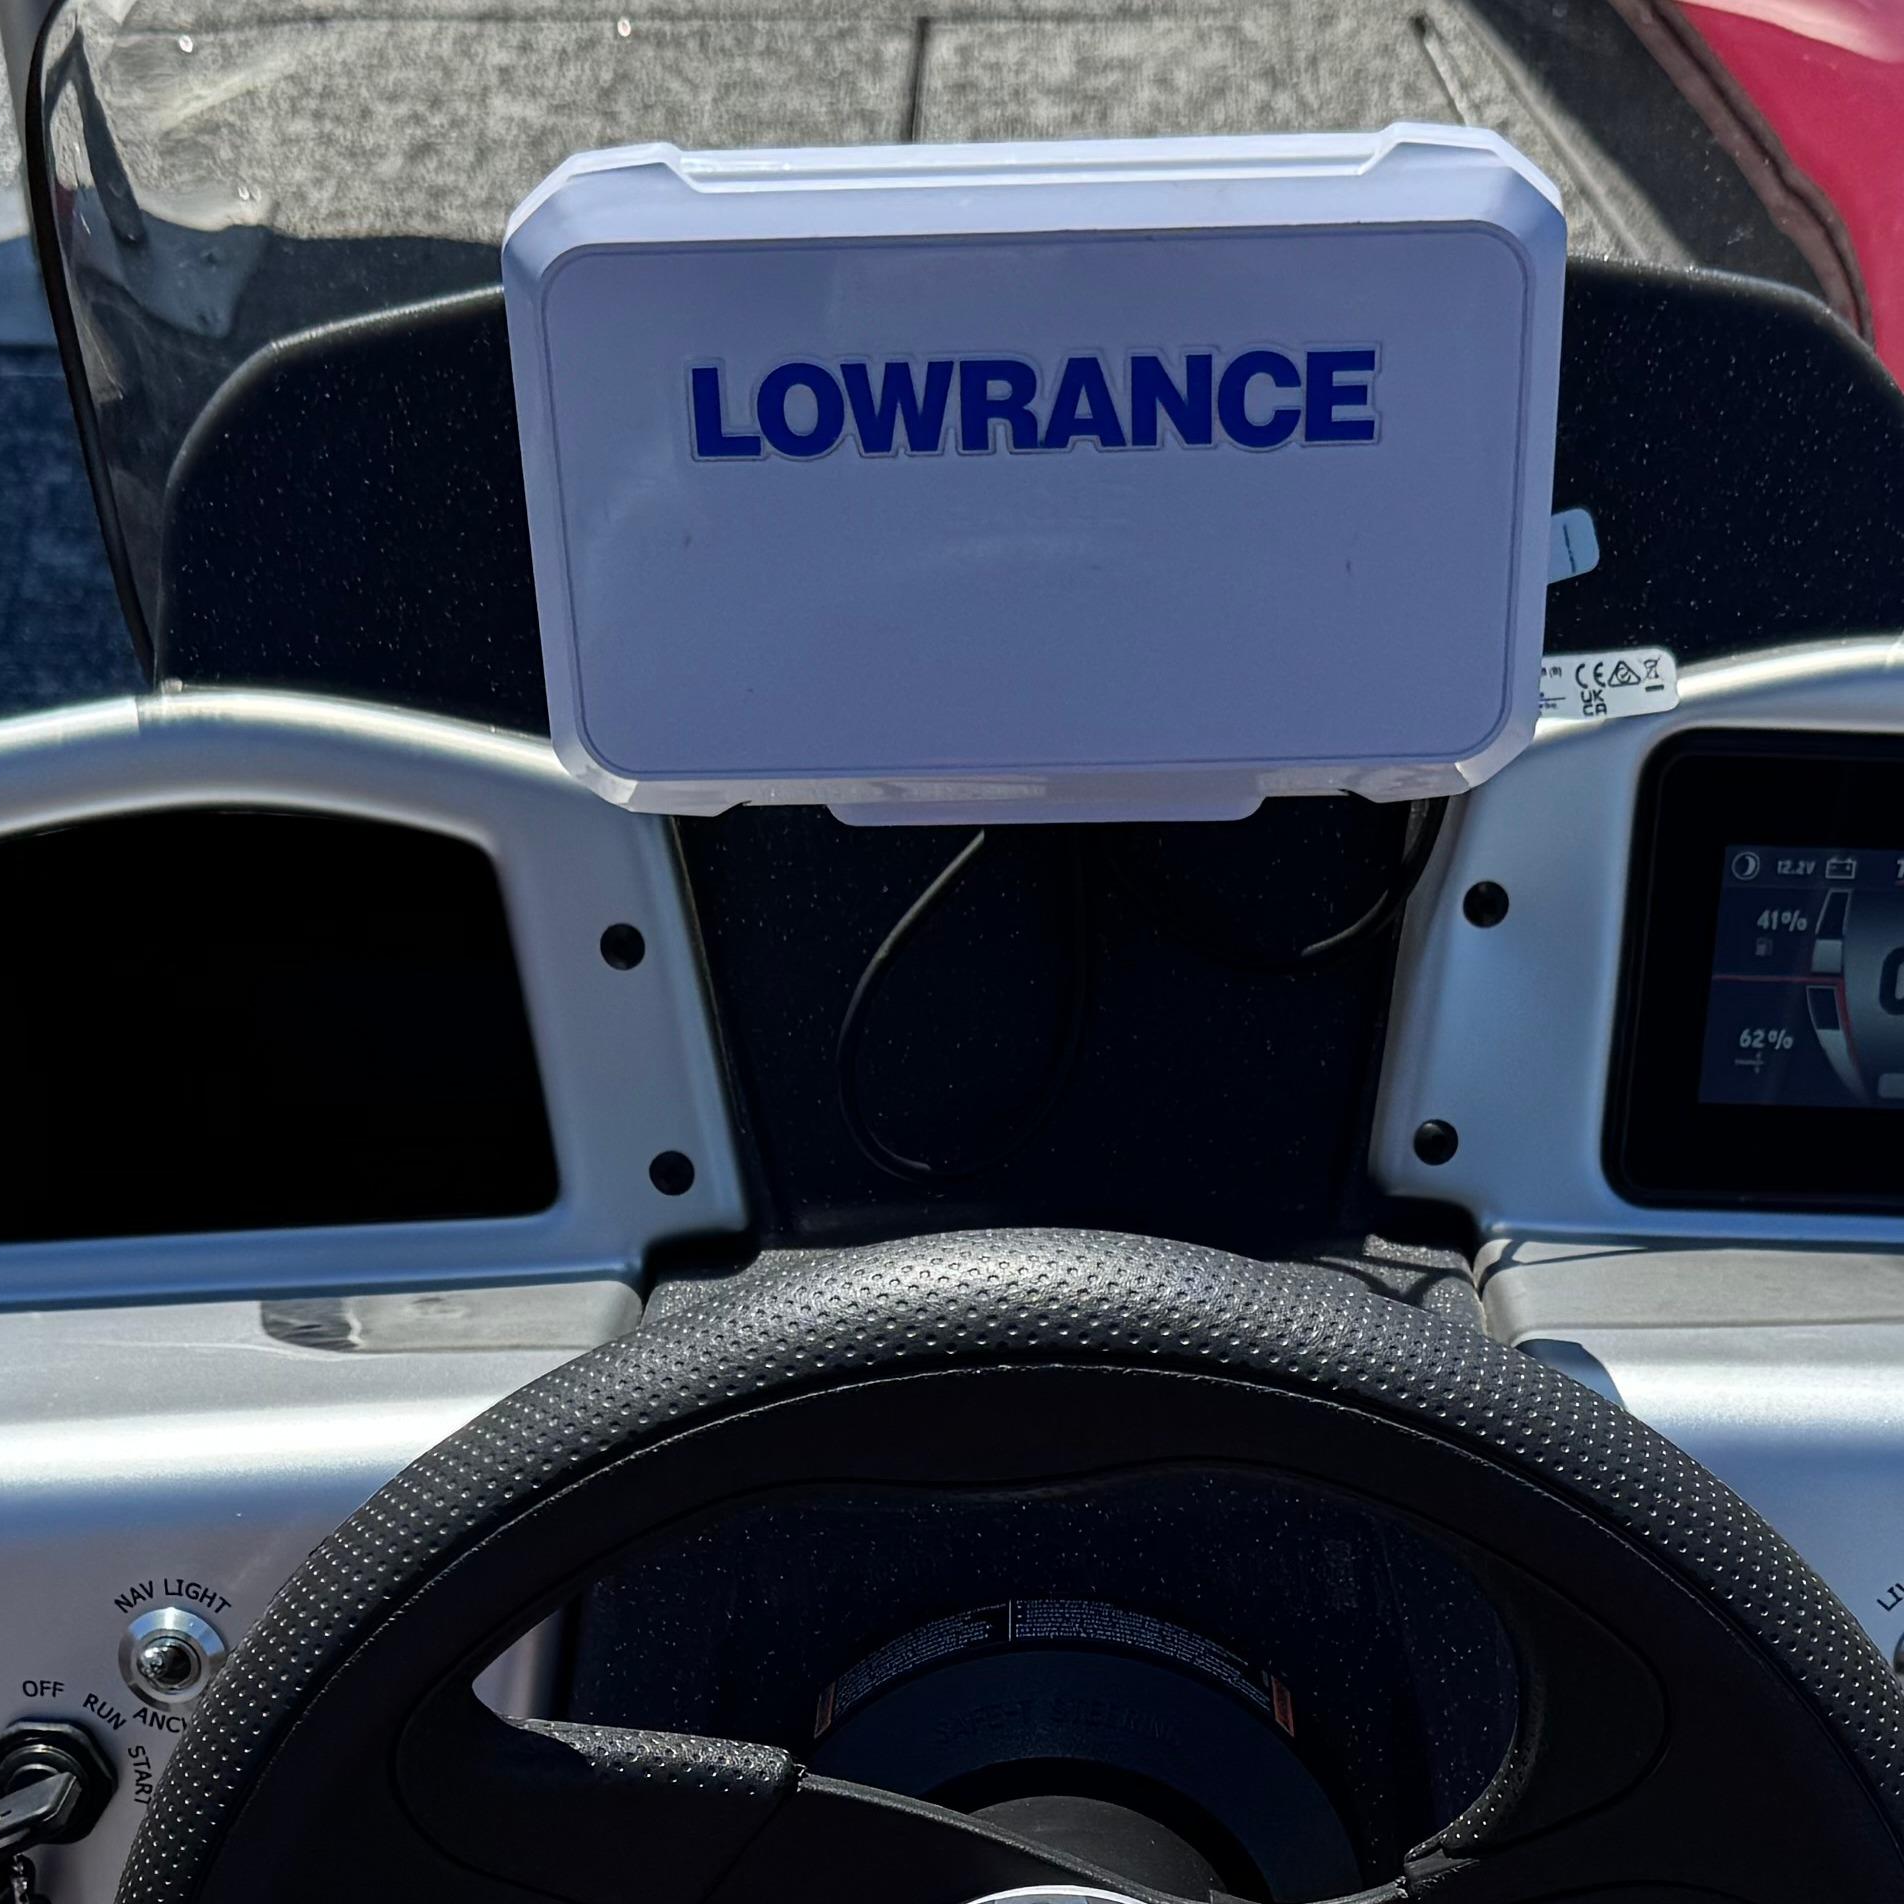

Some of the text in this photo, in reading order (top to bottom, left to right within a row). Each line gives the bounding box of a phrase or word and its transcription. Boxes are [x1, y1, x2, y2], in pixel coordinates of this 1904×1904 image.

[690, 349, 1377, 459] LOWRANCE
[1756, 909, 1808, 932] 41%
[1739, 1028, 1794, 1050] 62%
[114, 1578, 232, 1614] NAV LIGHT
[22, 1680, 65, 1698] OFF
[82, 1692, 128, 1731] RUN
